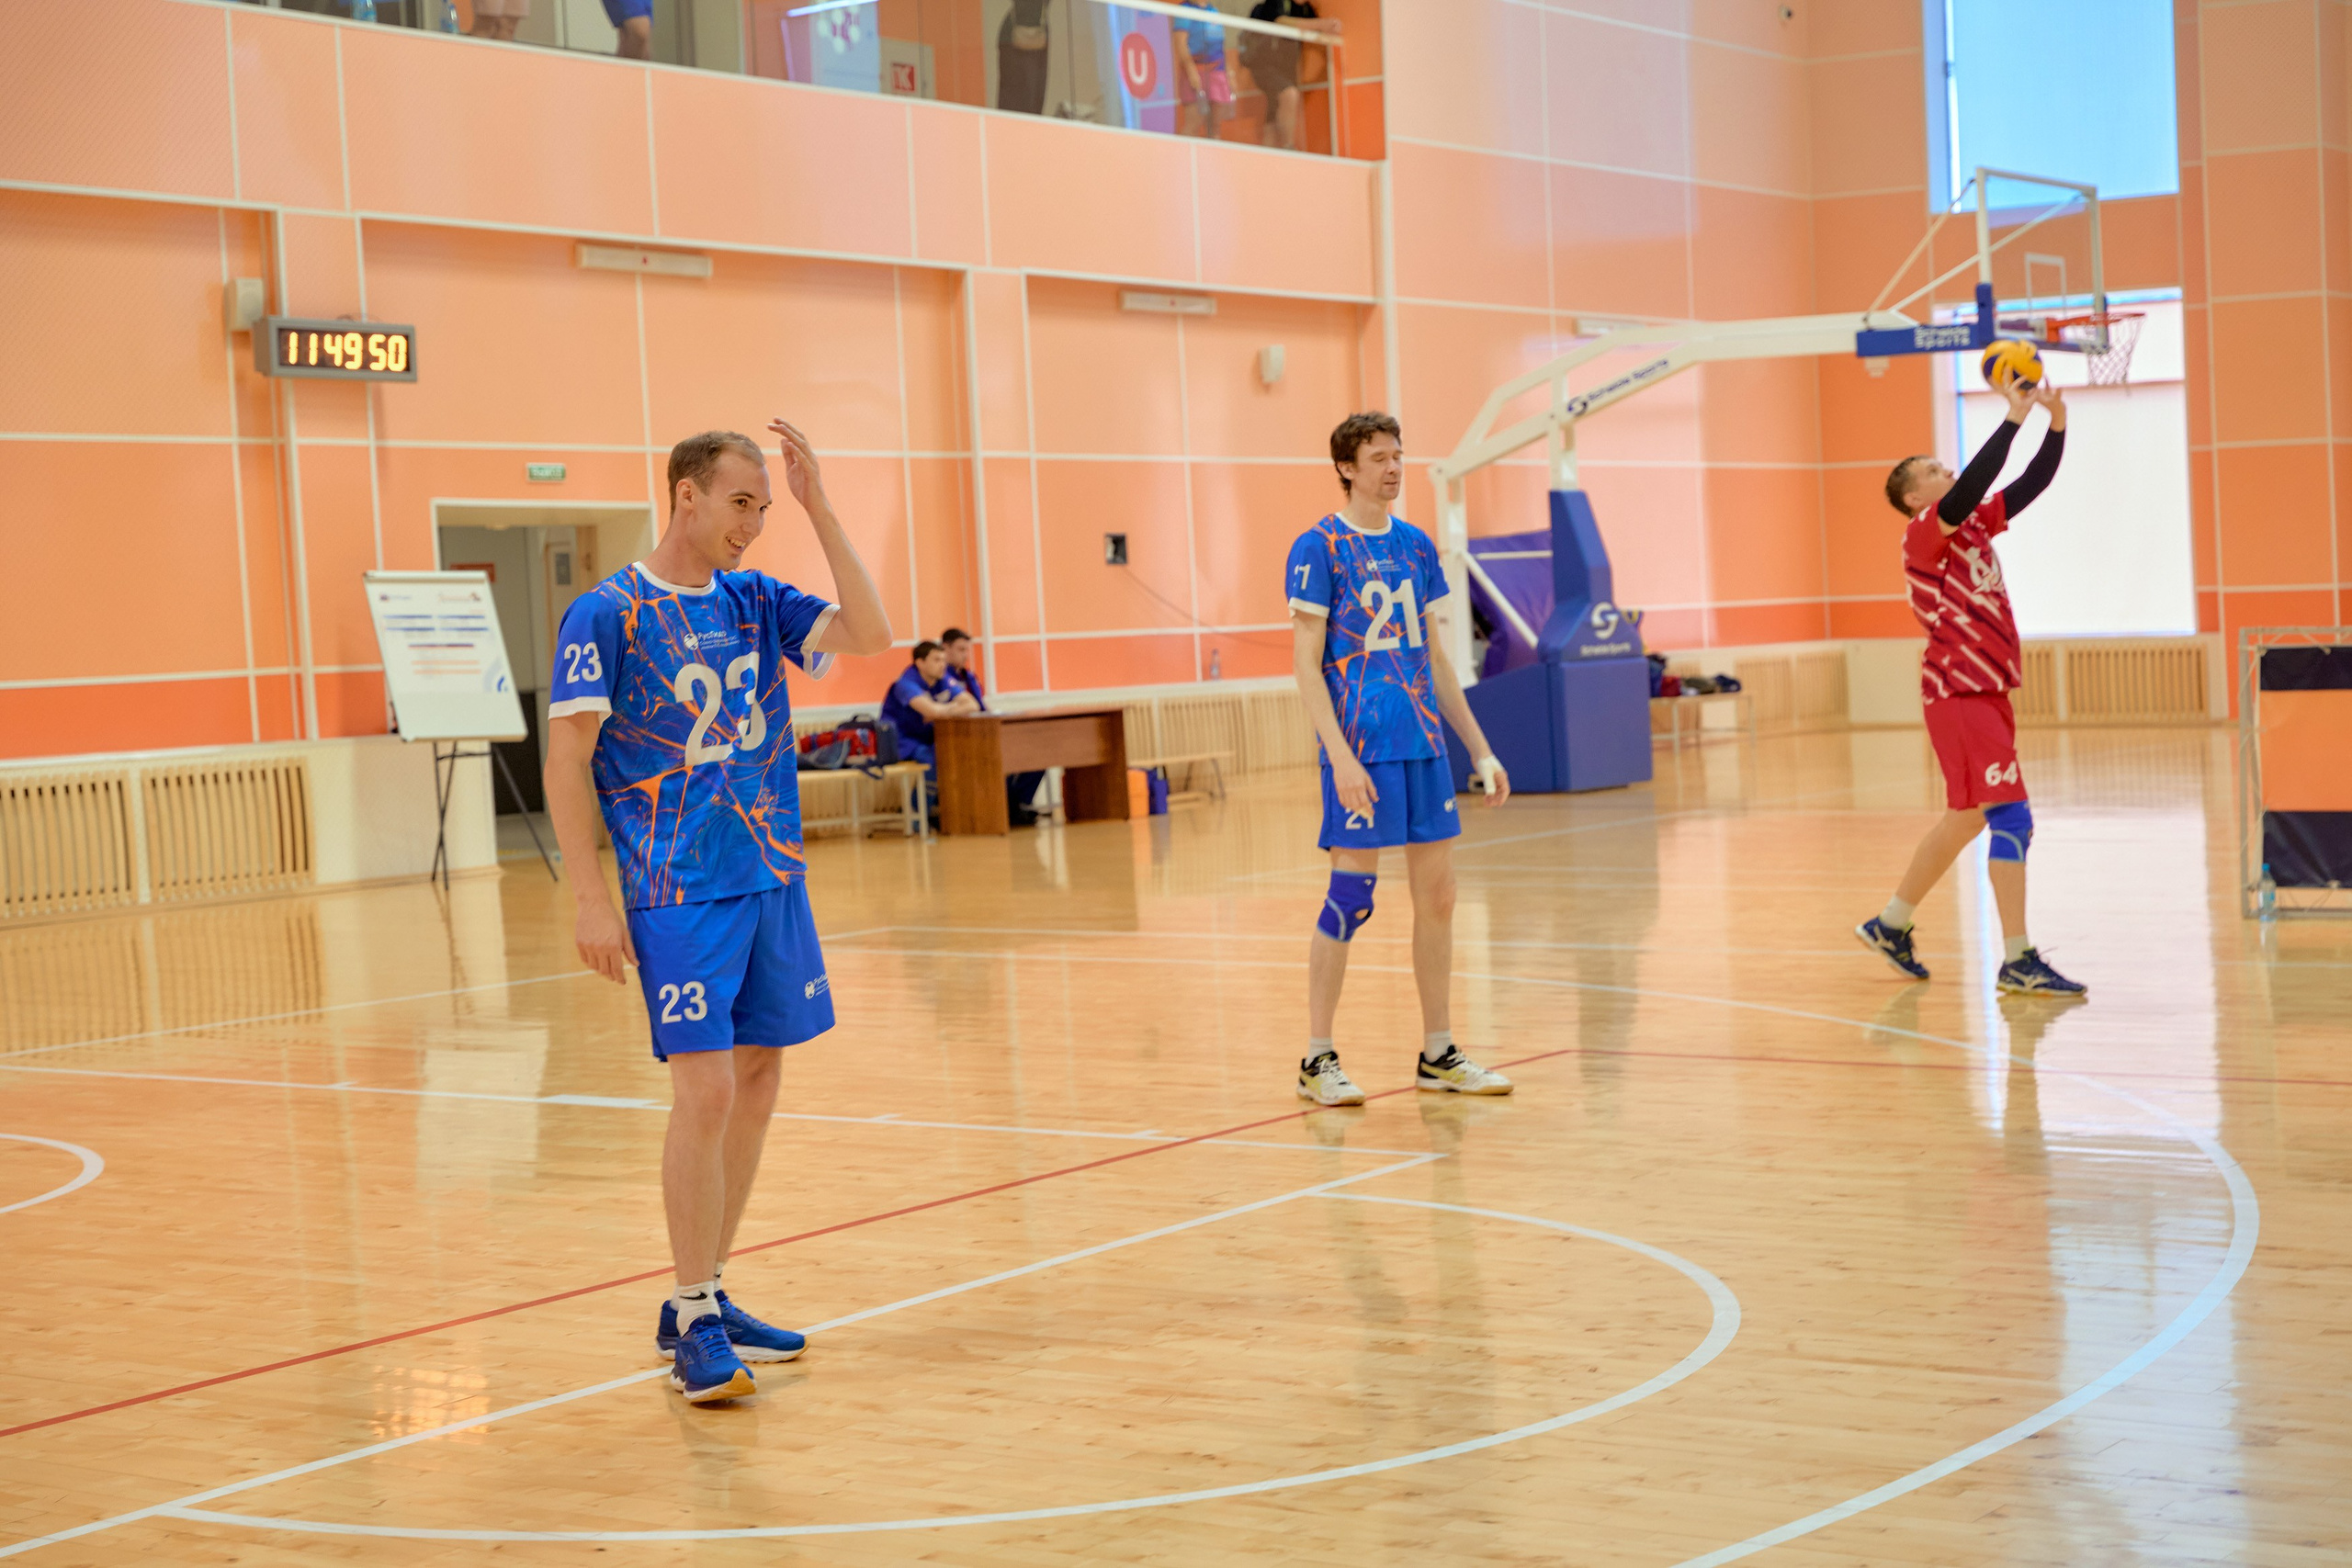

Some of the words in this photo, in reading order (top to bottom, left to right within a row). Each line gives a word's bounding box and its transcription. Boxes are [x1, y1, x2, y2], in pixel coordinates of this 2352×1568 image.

[1361, 579, 1422, 651] 21
[564, 642, 603, 684] 23
[674, 651, 766, 766] 23
[1985, 761, 2018, 786] 64
[659, 981, 707, 1024] 23
